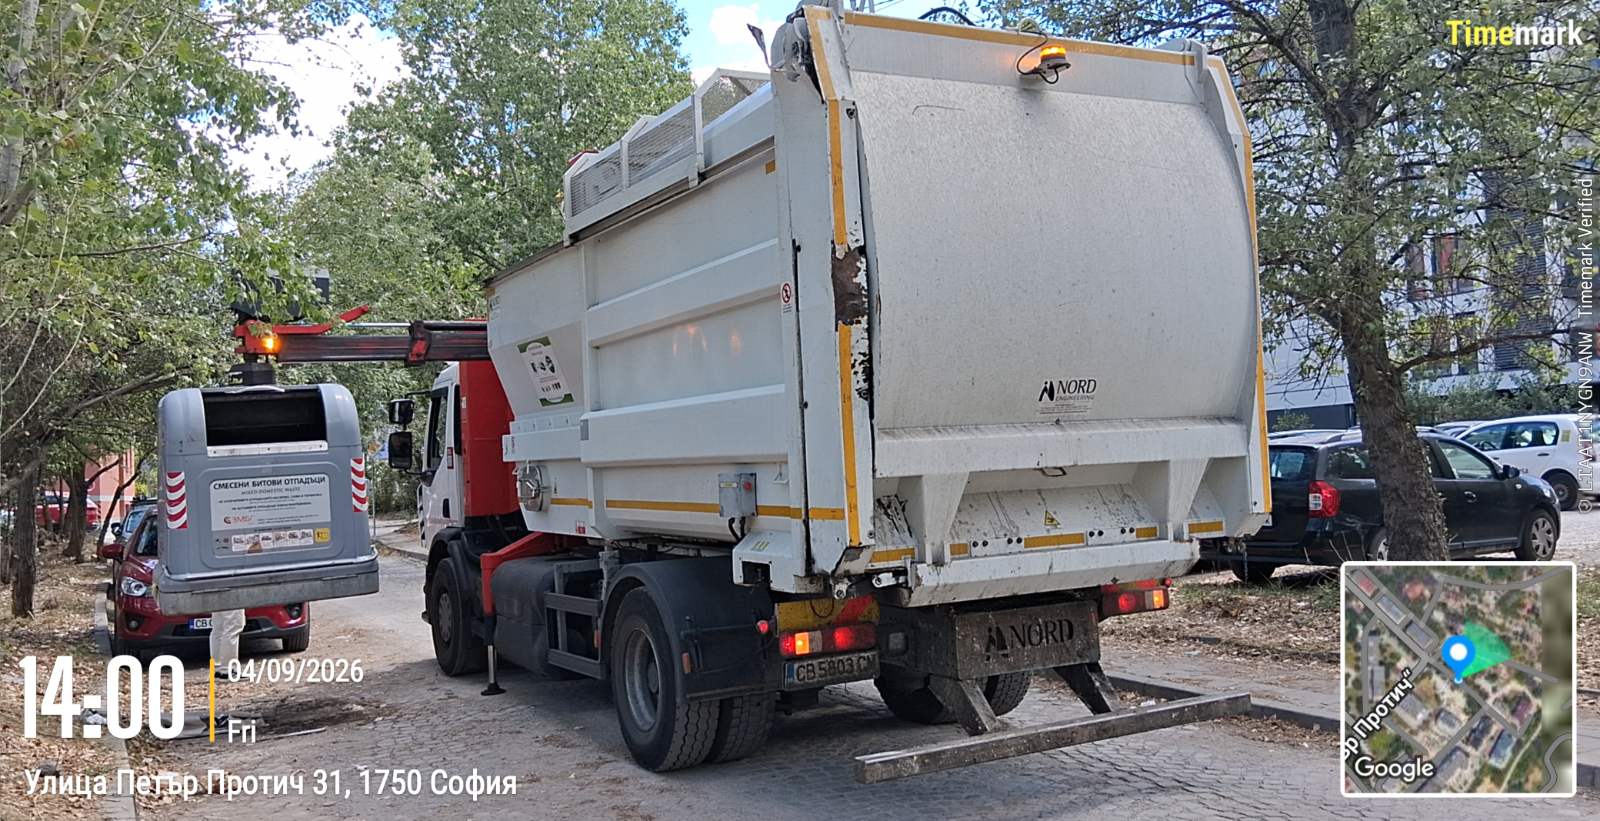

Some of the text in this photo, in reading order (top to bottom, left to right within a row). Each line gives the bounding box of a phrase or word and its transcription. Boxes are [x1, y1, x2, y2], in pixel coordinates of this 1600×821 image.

[1057, 379, 1097, 395] NORD
[213, 476, 326, 490] СМЕСЕНИ БИТОВИ ОТПАДЪЦИ
[1009, 618, 1074, 649] NORD
